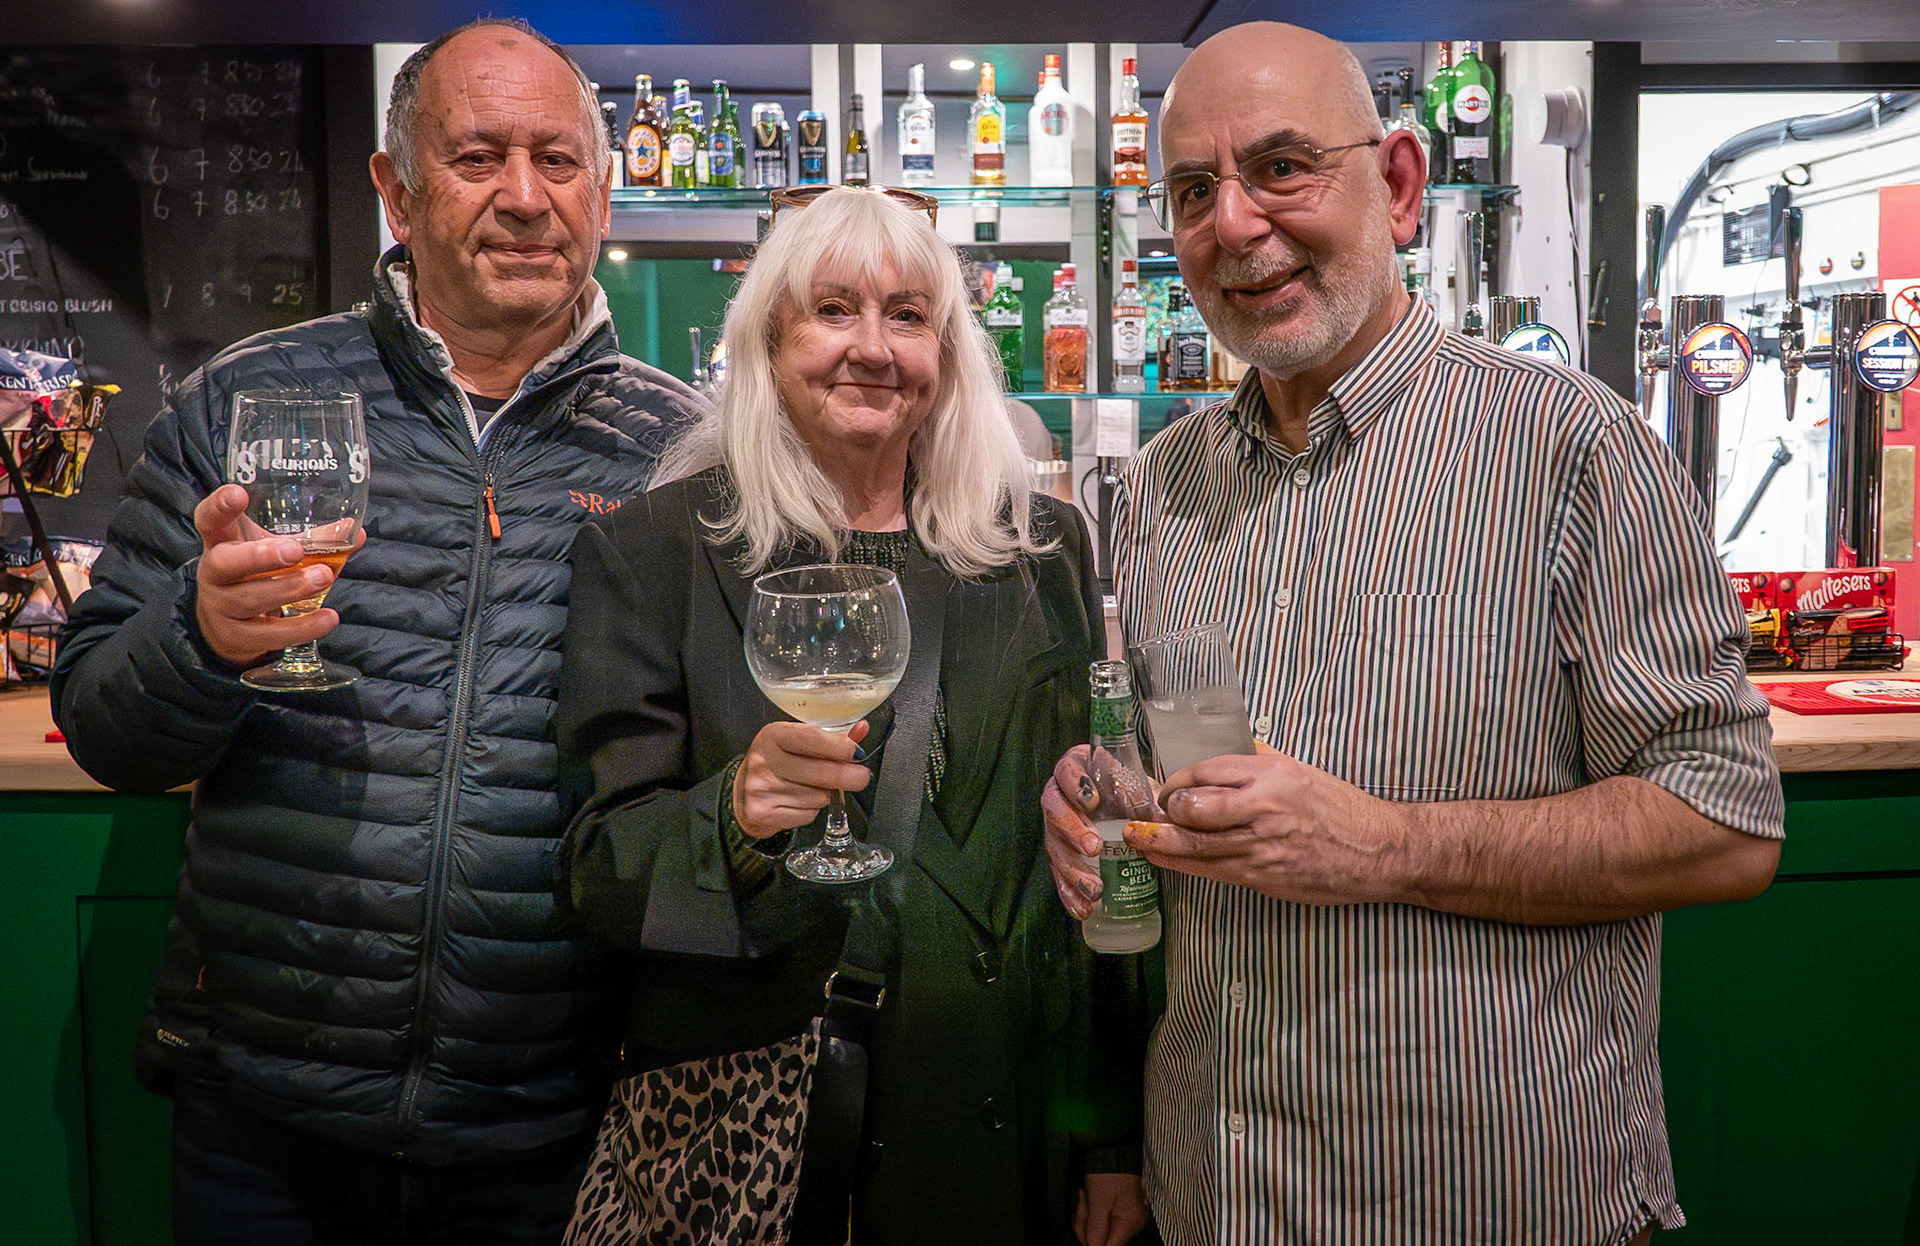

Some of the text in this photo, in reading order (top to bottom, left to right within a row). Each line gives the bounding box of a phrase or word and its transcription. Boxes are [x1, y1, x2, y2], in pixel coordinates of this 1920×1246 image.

[149, 146, 169, 185] 6
[64, 298, 113, 314] BLUSH
[1690, 359, 1745, 374] PILSNER
[271, 458, 338, 471] CURIOUS
[1797, 575, 1871, 611] Maltesers
